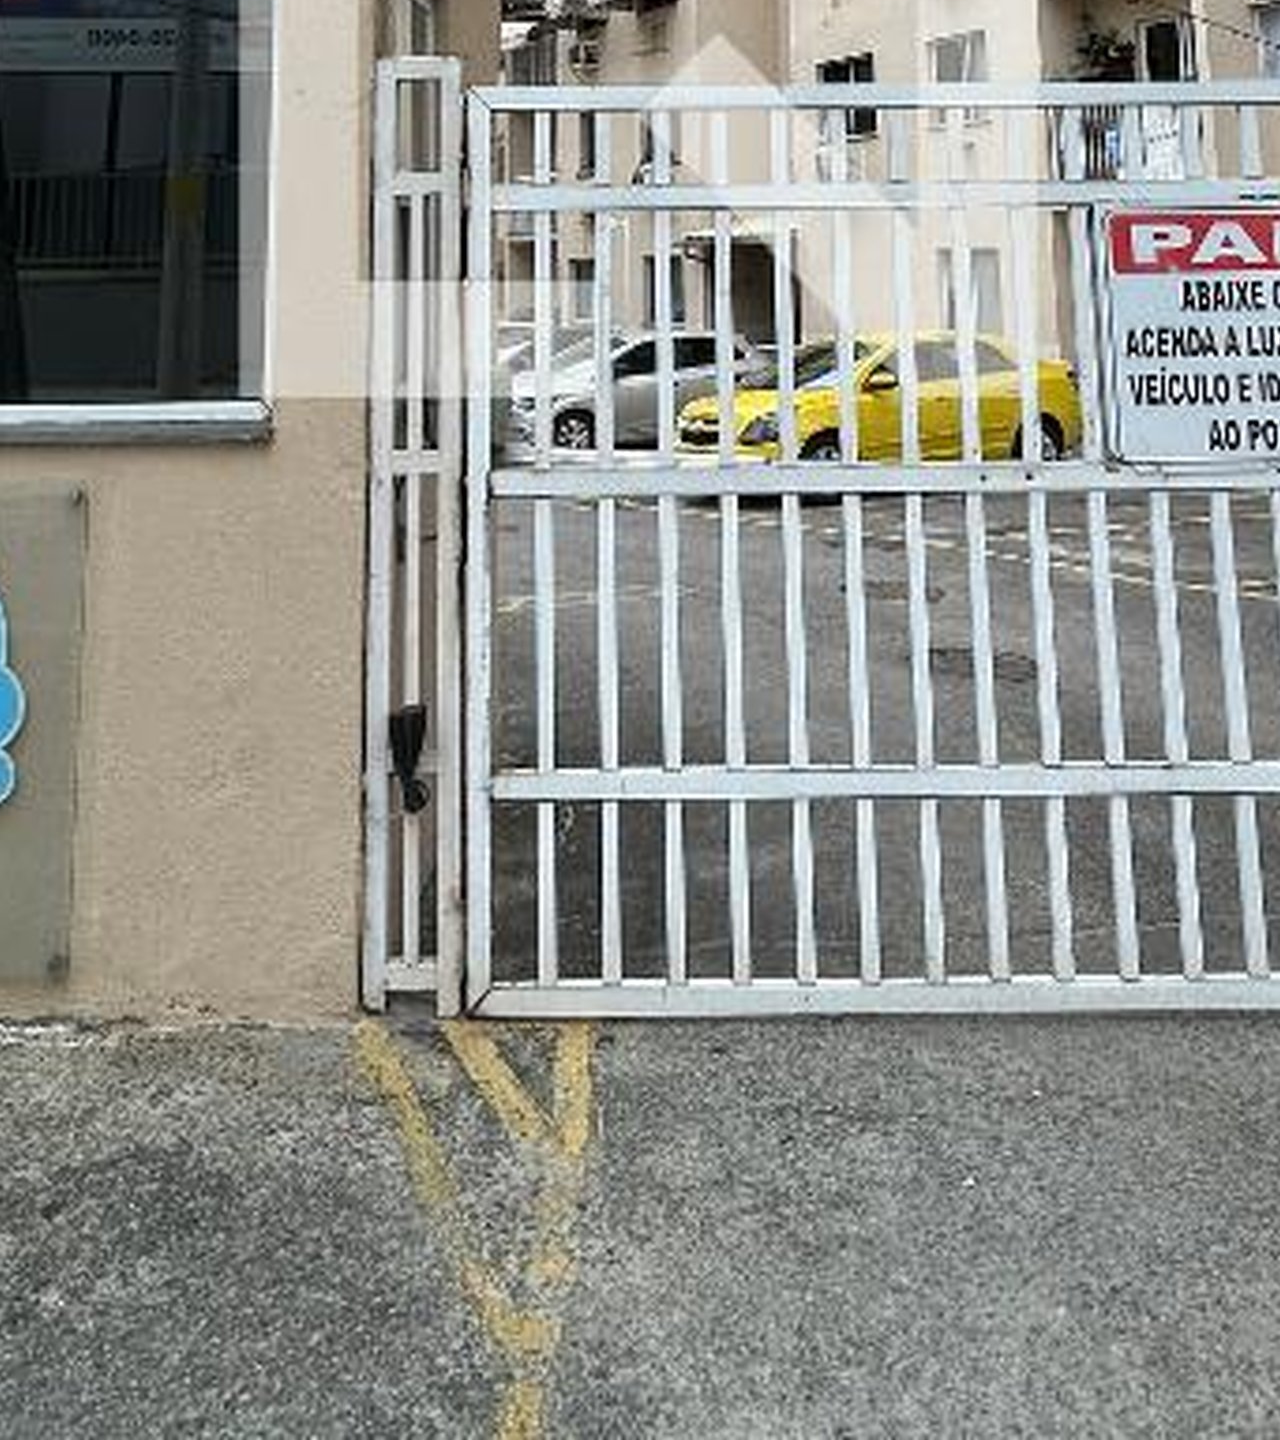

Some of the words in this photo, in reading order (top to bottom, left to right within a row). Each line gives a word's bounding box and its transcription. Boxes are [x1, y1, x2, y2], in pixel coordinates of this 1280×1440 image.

[1182, 280, 1267, 311] ABAIXE
[1127, 327, 1218, 358] ACENDA
[1224, 326, 1241, 357] A
[1129, 366, 1230, 405] VEÍCULO
[1239, 374, 1252, 402] E
[1209, 420, 1240, 451] AO
